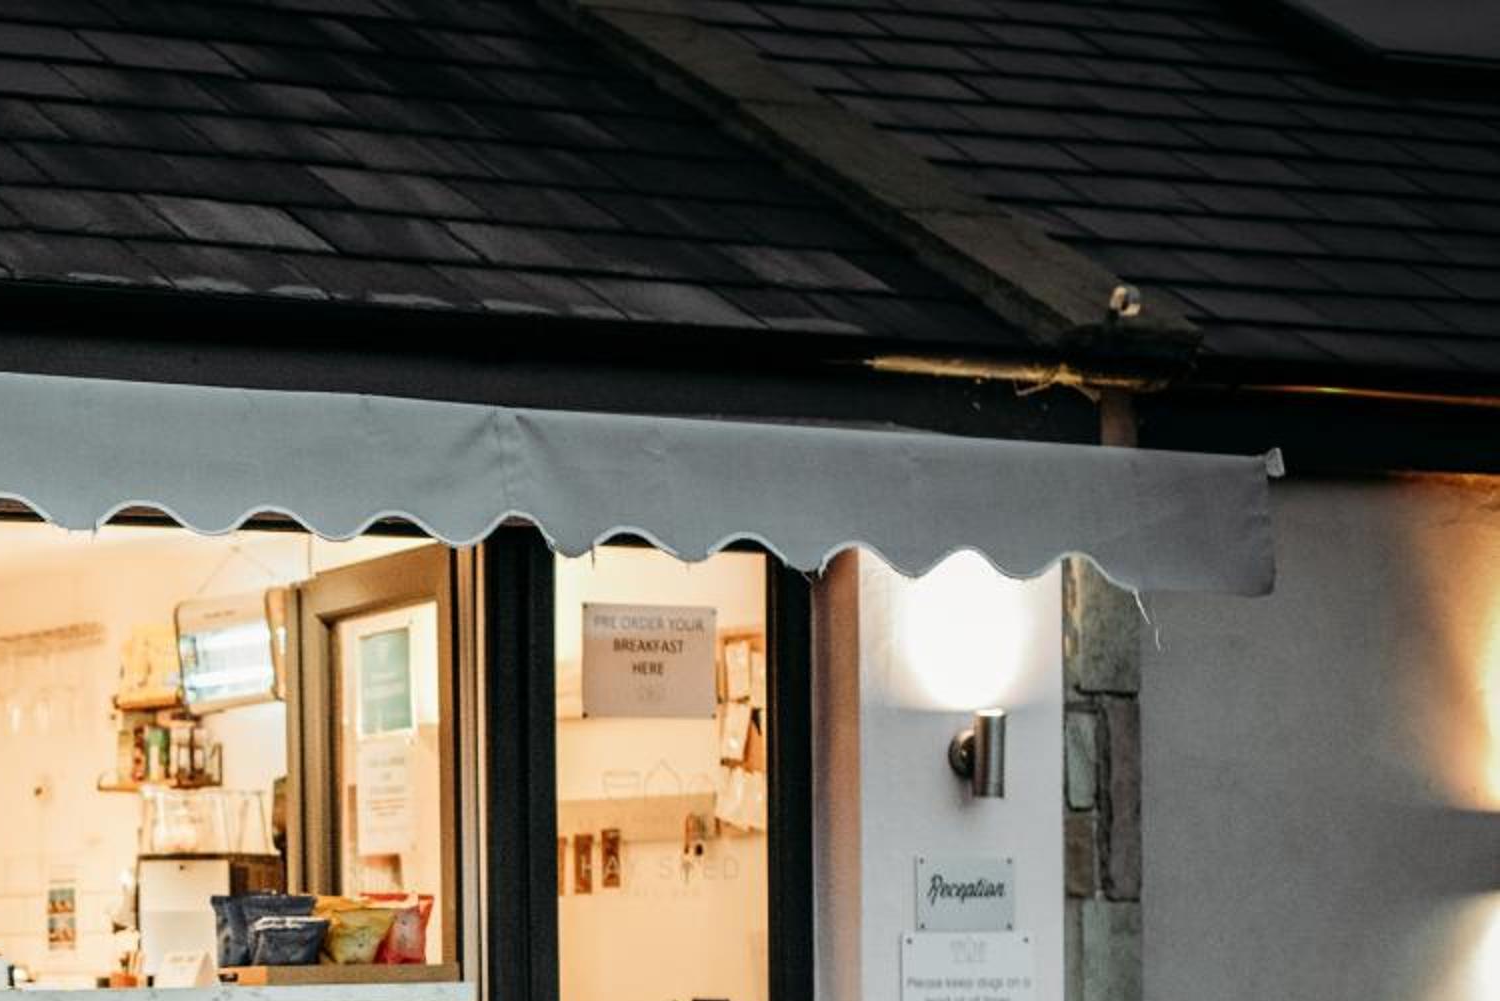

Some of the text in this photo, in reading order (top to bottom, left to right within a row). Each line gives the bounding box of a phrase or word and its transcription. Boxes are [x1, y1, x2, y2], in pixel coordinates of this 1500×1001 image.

[612, 637, 684, 654] BREAKFAST
[631, 661, 664, 676] HERE
[927, 873, 1005, 907] Reception
